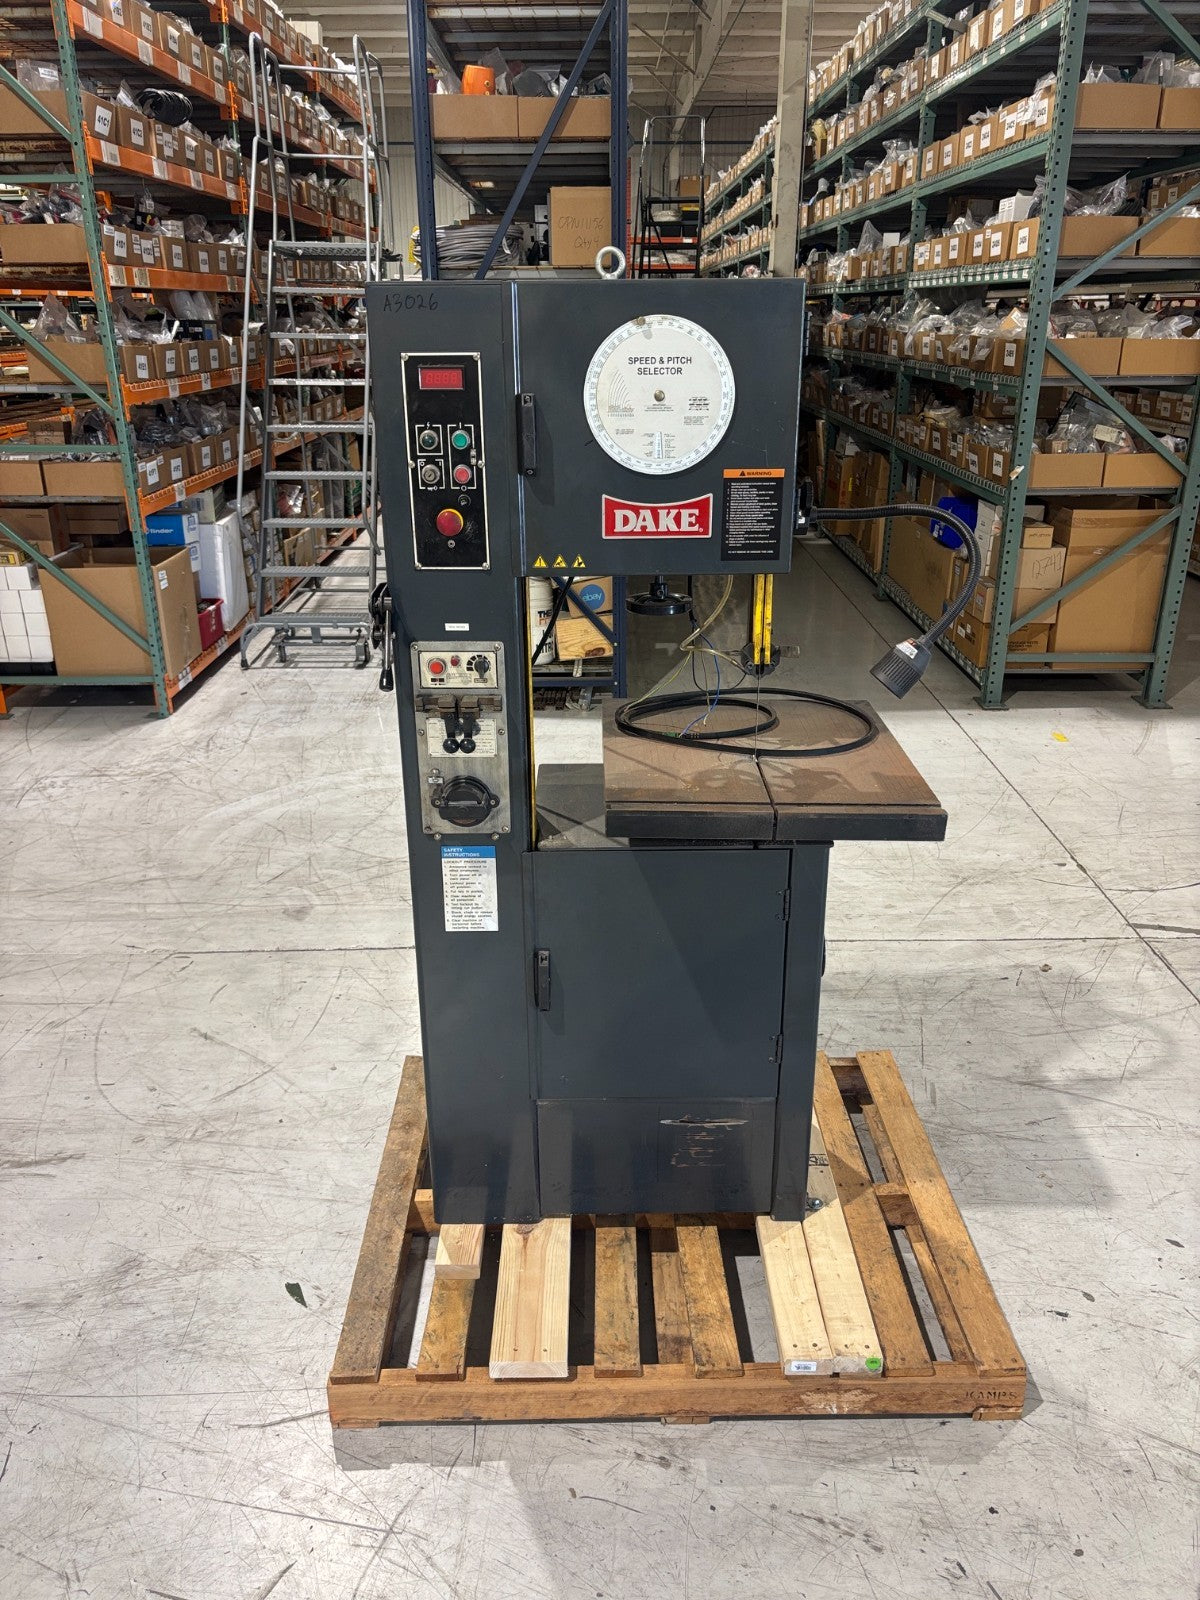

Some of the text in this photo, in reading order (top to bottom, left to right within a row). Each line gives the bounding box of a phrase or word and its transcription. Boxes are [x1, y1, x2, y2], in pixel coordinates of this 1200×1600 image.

[97, 115, 110, 128] 41C1
[383, 293, 439, 313] A3026
[628, 356, 693, 366] SPEED & PITCH
[637, 367, 683, 376] SELECTOR
[613, 508, 700, 533] DAKE
[582, 592, 603, 603] ebay
[537, 609, 553, 618] THE
[965, 1391, 1018, 1400] KAMPS
